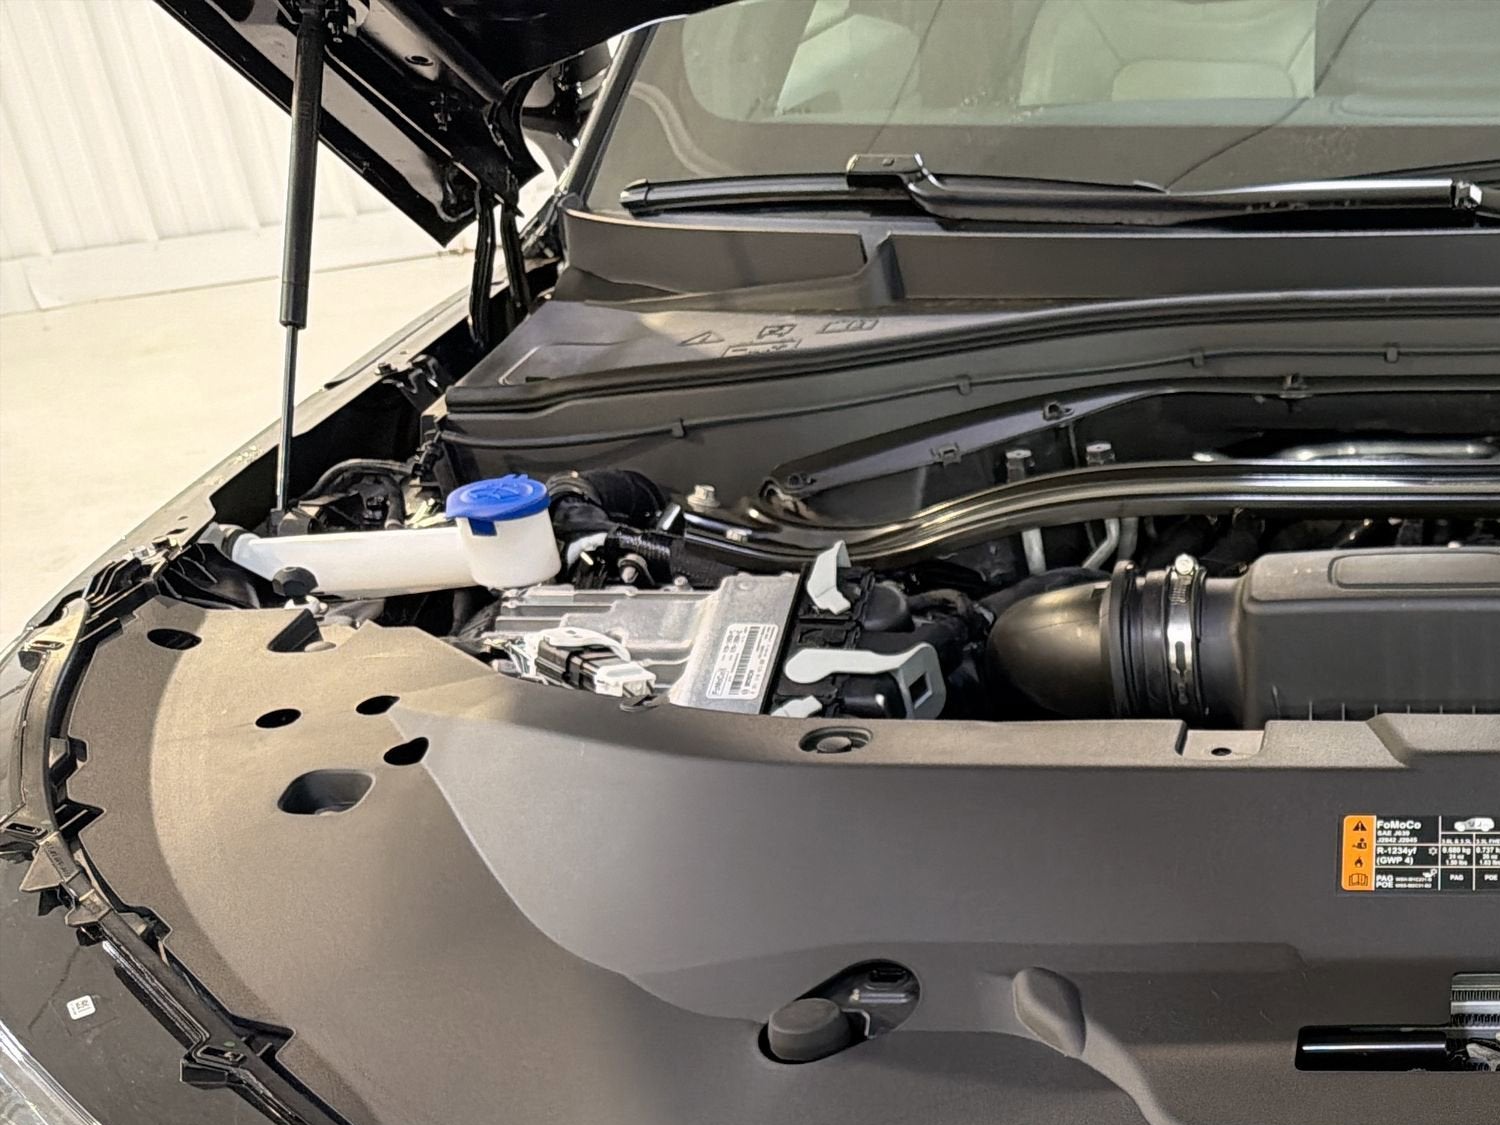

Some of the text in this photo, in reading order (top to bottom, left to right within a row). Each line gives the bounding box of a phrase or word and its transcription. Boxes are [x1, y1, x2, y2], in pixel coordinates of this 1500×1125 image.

[1377, 820, 1422, 829] FoMoCo
[1376, 846, 1417, 856] R-1234yf
[1462, 847, 1471, 855] kg
[1376, 856, 1414, 865] (GWP 4)
[1376, 874, 1394, 882] PAG
[1376, 881, 1393, 889] POE
